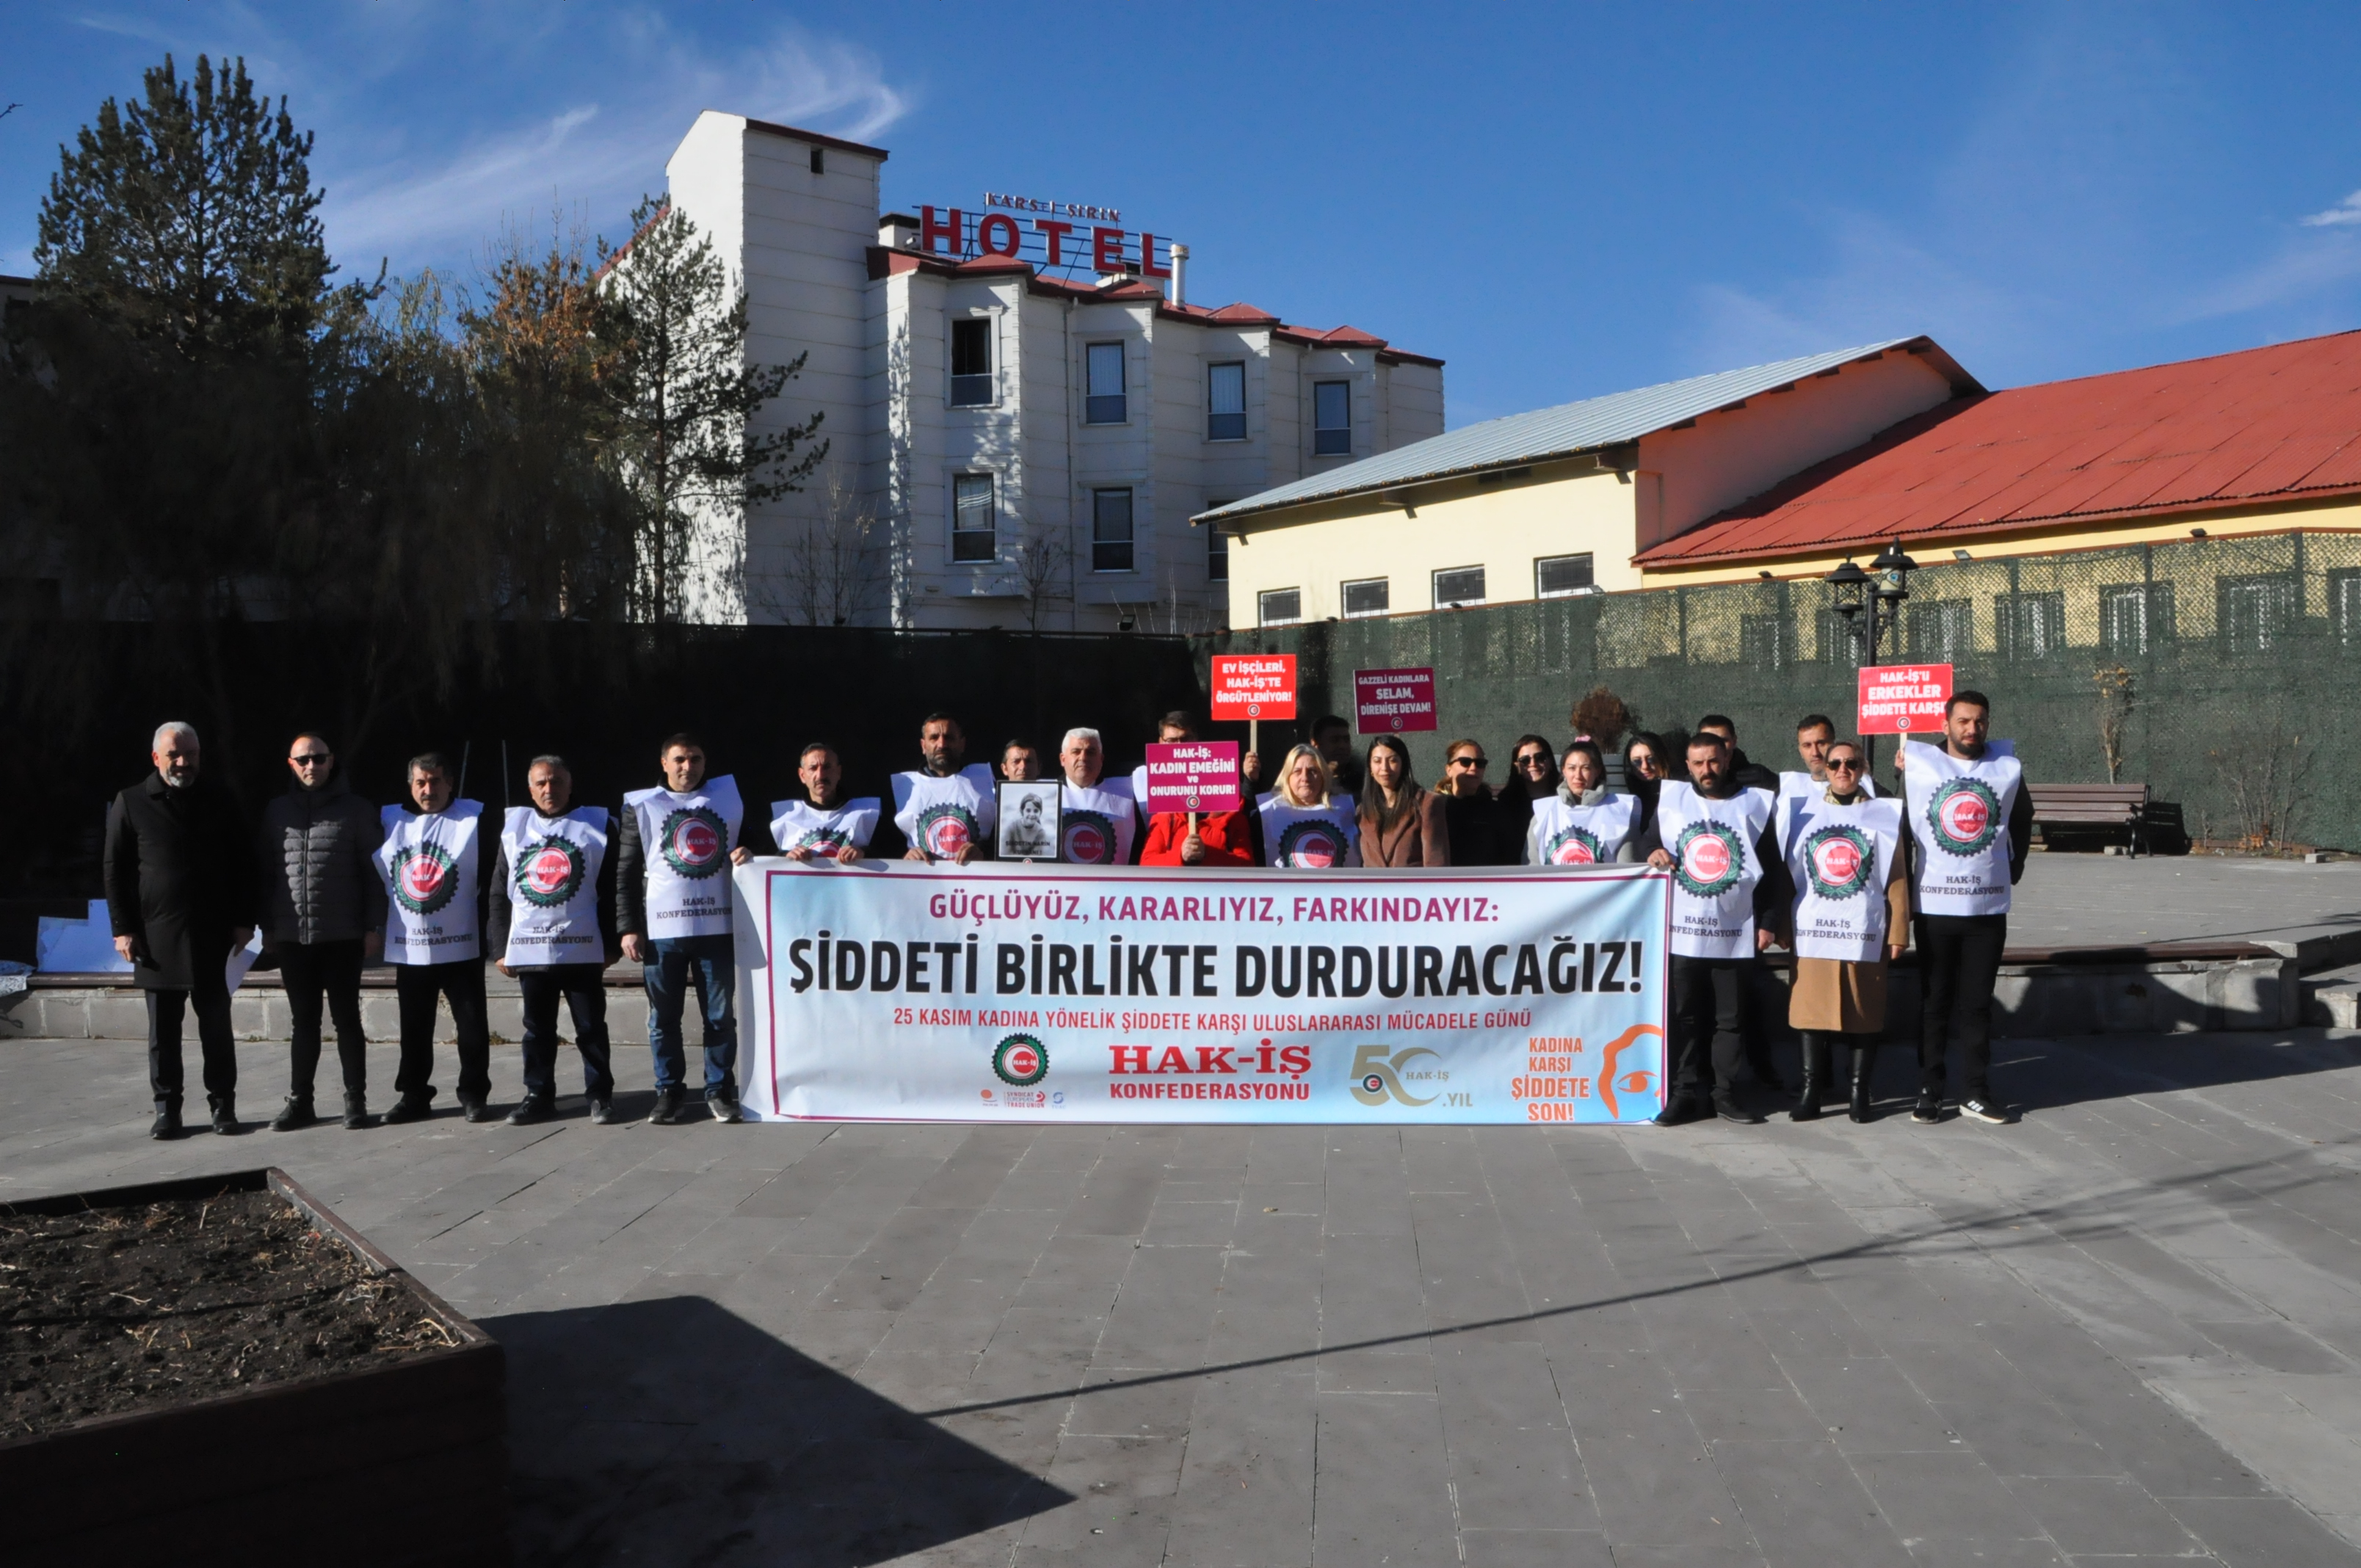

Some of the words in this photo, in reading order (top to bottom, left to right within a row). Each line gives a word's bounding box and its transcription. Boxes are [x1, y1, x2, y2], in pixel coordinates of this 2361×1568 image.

[921, 205, 1171, 279] HOTEL
[1222, 664, 1237, 673] EV
[1239, 660, 1285, 675] İŞÇİLERİ,
[1227, 676, 1281, 689] HAK-İŞ'TE
[1358, 674, 1387, 686] GAZZELİ
[1388, 674, 1429, 685] KADINLARA
[1216, 689, 1292, 705] ÖRGÜTLENİYOR!
[1377, 687, 1415, 700] SELAM,
[1868, 684, 1941, 700] ERKEKLER
[1360, 703, 1399, 716] DİRENİŞE
[1399, 702, 1431, 714] DEVAM!
[1861, 701, 1907, 719] ŞİDDETE
[1173, 747, 1211, 761] HAK-İŞ:
[1150, 761, 1187, 774] KADIN
[1189, 758, 1235, 774] EMEĞİNİ
[1186, 776, 1199, 784] ve
[1150, 786, 1197, 796] ONURUNU
[1200, 784, 1236, 796] KORUR!
[1954, 813, 1985, 821] HAK-İŞ
[537, 865, 568, 874] HAK-İŞ
[1946, 875, 1981, 885] HAK-İŞ
[1920, 885, 2004, 896] KONFEDERASYONU
[682, 896, 716, 906] HAK-İŞ
[930, 889, 1088, 926] GÜÇLÜYÜZ,
[1099, 896, 1283, 925] KARARLIYIZ,
[1294, 897, 1499, 923] FARKINDAYIZ:
[1684, 915, 1719, 927] HAK-İŞ
[1816, 918, 1851, 929] HAK-İŞ
[1669, 925, 1742, 937] NFEDERASYONU
[789, 930, 979, 994] ŞİDDETİ
[996, 934, 1218, 997] BİRLİKTE
[1236, 936, 1642, 998] DURDURACAĞIZ!
[893, 1008, 913, 1025] 25
[919, 1009, 972, 1026] KASIM
[978, 1009, 1040, 1028] KADINA
[1045, 1007, 1115, 1029] YÖNELİK
[1122, 1009, 1190, 1034] ŞİDDETE
[1197, 1013, 1247, 1036] KARŞI
[1252, 1013, 1381, 1031] ULUSLARARASI
[1387, 1009, 1479, 1030] MÜCADELE
[1484, 1008, 1531, 1028] GÜNÜ
[1528, 1037, 1584, 1053] KADINA
[1109, 1038, 1311, 1080] HAK-İŞ
[1529, 1056, 1572, 1073] KARŞI
[1406, 1070, 1449, 1082] HAK-İŞ
[1109, 1083, 1310, 1101] KONFEDERASYONU
[1511, 1077, 1590, 1100] ŞİDDETE
[1528, 1103, 1574, 1121] SON!
